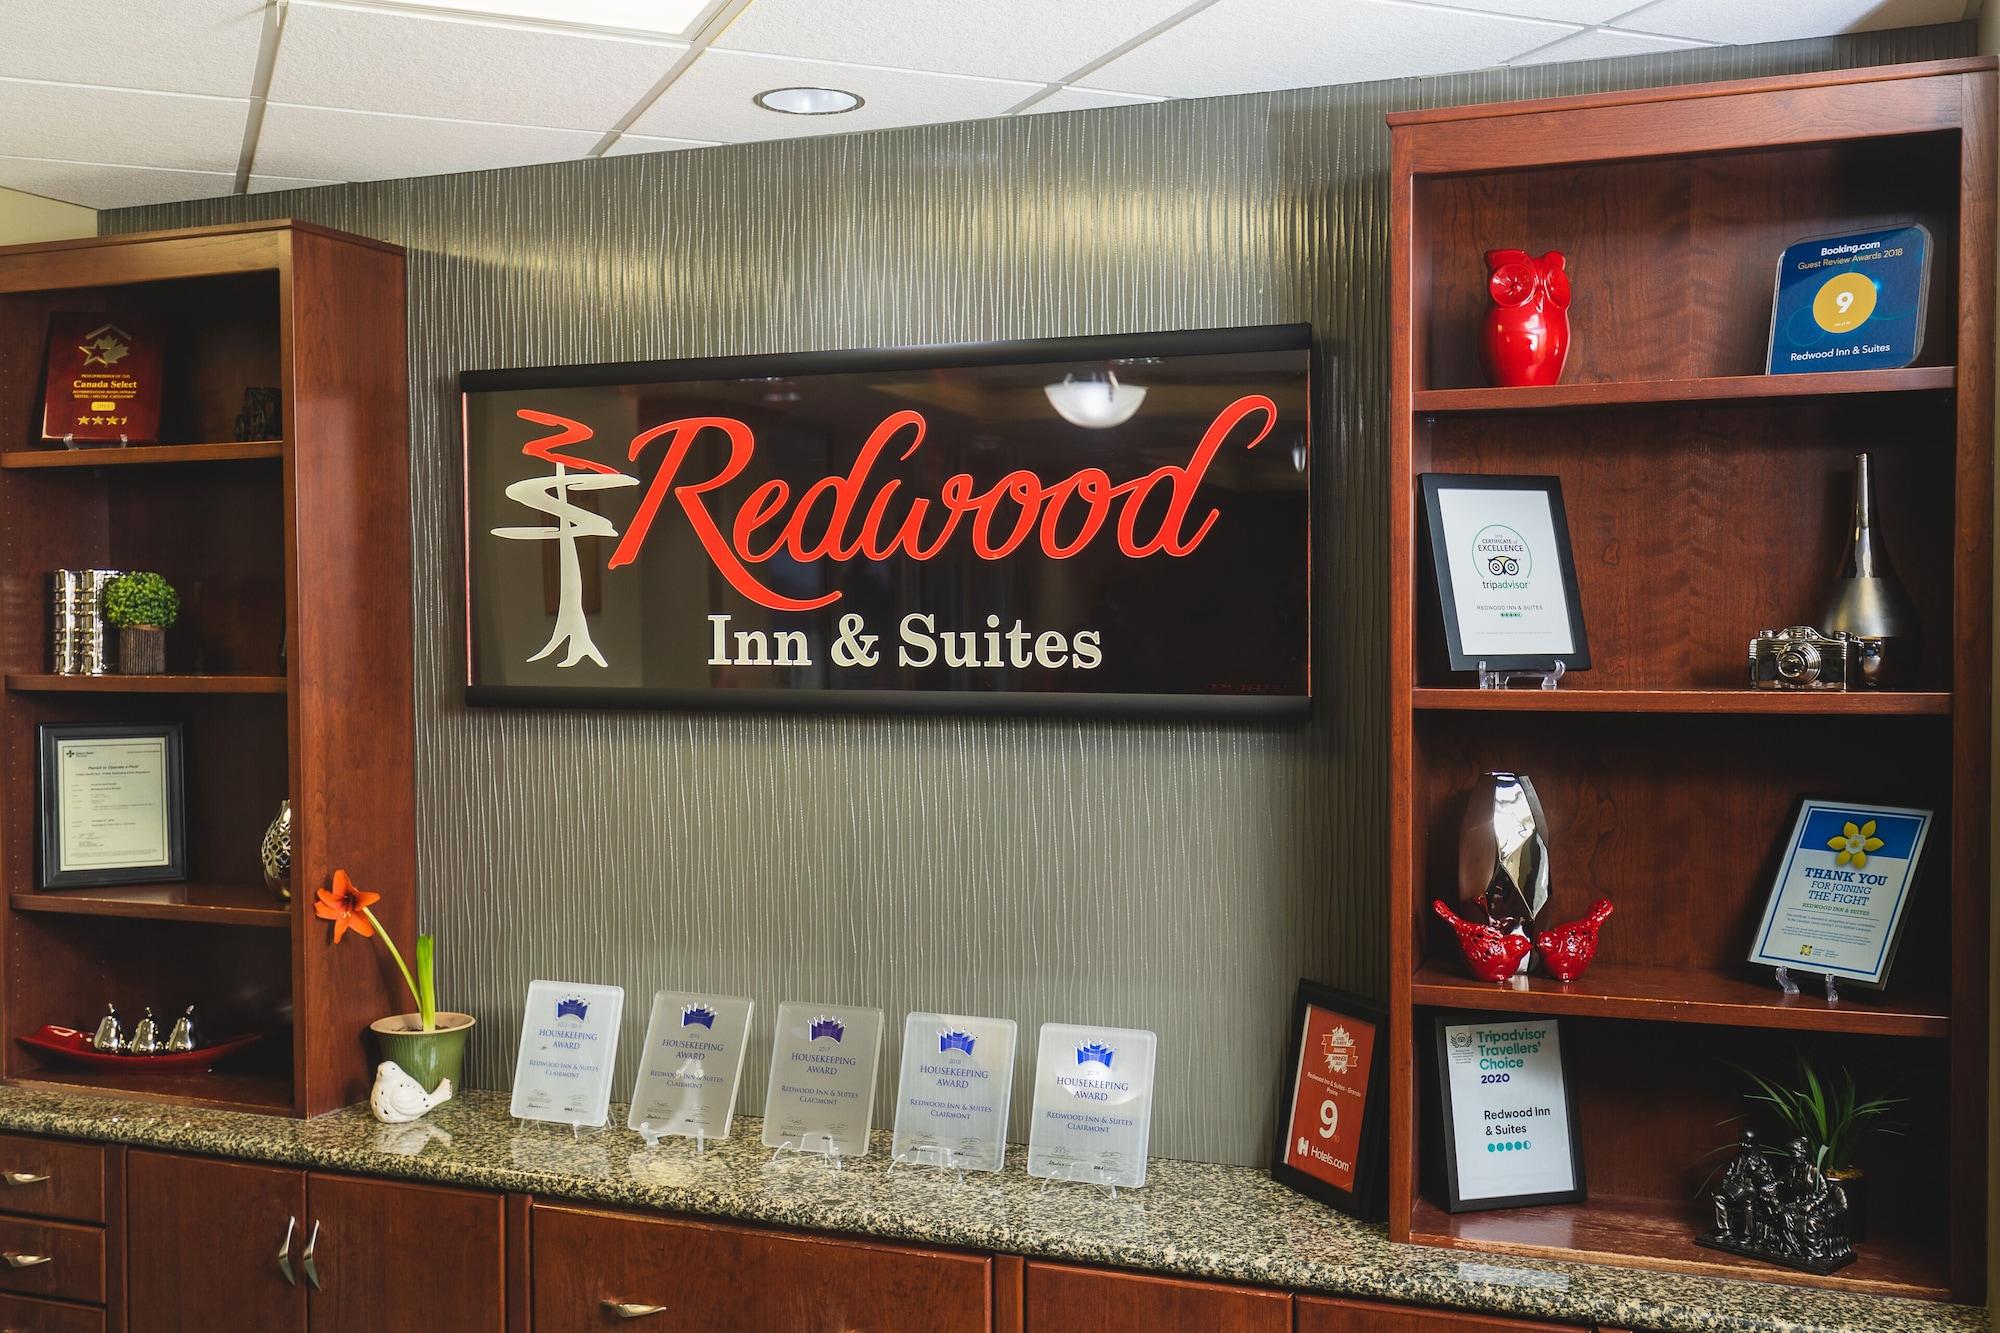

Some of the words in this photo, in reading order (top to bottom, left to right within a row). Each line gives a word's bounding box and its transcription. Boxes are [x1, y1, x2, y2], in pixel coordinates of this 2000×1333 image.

[1821, 241, 1880, 256] Booking.com
[1798, 261, 1821, 270] Guest
[1823, 257, 1851, 266] Review
[1852, 252, 1882, 262] Awards
[1883, 248, 1903, 258] 2018
[1836, 291, 1854, 314] 9
[1790, 349, 1834, 361] Redwood
[1836, 348, 1850, 357] Inn
[1852, 346, 1860, 354] &
[1862, 343, 1891, 353] Suites
[73, 380, 108, 388] Canada
[110, 380, 137, 388] Select
[608, 394, 1278, 612] Redwood
[1482, 580, 1528, 590] tripadvisor
[707, 614, 812, 668] Inn
[830, 613, 880, 669] &
[898, 613, 1103, 670] Suites
[1805, 867, 1856, 882] THANK
[1858, 873, 1888, 886] YOU
[1811, 881, 1830, 891] FOR
[1831, 883, 1872, 895] JOINING
[1808, 890, 1832, 902] THE
[1833, 893, 1870, 906] FIGHT
[1802, 903, 1832, 911] REDWOOD
[539, 1028, 598, 1041] HOUSEKEEPING
[1476, 1028, 1547, 1045] Tripadvisor
[553, 1041, 580, 1050] AWARD
[662, 1039, 724, 1052] HOUSEKEEPING
[1477, 1042, 1542, 1057] Travellers'
[675, 1051, 705, 1061] AWARD
[791, 1052, 857, 1066] HOUSEKEEPING
[529, 1059, 560, 1069] REDWOOD
[806, 1065, 838, 1075] AWARD
[1479, 1058, 1524, 1071] Choice
[545, 1069, 580, 1078] CLAIRMONT
[920, 1065, 989, 1079] HOUSEKEEPING
[1481, 1073, 1510, 1084] 2020
[667, 1081, 704, 1089] CLAIRMONT
[703, 1075, 724, 1083] SUITES
[936, 1078, 969, 1089] AWARD
[1056, 1076, 1129, 1091] HOUSEKEEPING
[781, 1085, 815, 1095] REDWOOD
[816, 1088, 829, 1096] INN
[837, 1090, 859, 1098] SUITES
[1073, 1090, 1108, 1101] AWARD
[910, 1098, 946, 1108] REDWOOD
[947, 1102, 961, 1110] INN
[962, 1103, 968, 1111] &
[969, 1104, 993, 1113] SUITES
[930, 1109, 971, 1120] CLAIRMONT
[1047, 1110, 1084, 1121] REDWOOD
[1085, 1115, 1100, 1123] INN
[1108, 1117, 1133, 1126] SUITES
[1319, 1099, 1338, 1139] 9
[1484, 1107, 1533, 1120] Redwood
[1535, 1106, 1551, 1116] Inn
[1067, 1122, 1110, 1133] CLAIRMONT
[1485, 1125, 1493, 1136] &
[1495, 1124, 1527, 1135] Suites
[1311, 1145, 1349, 1172] Hotels.com
